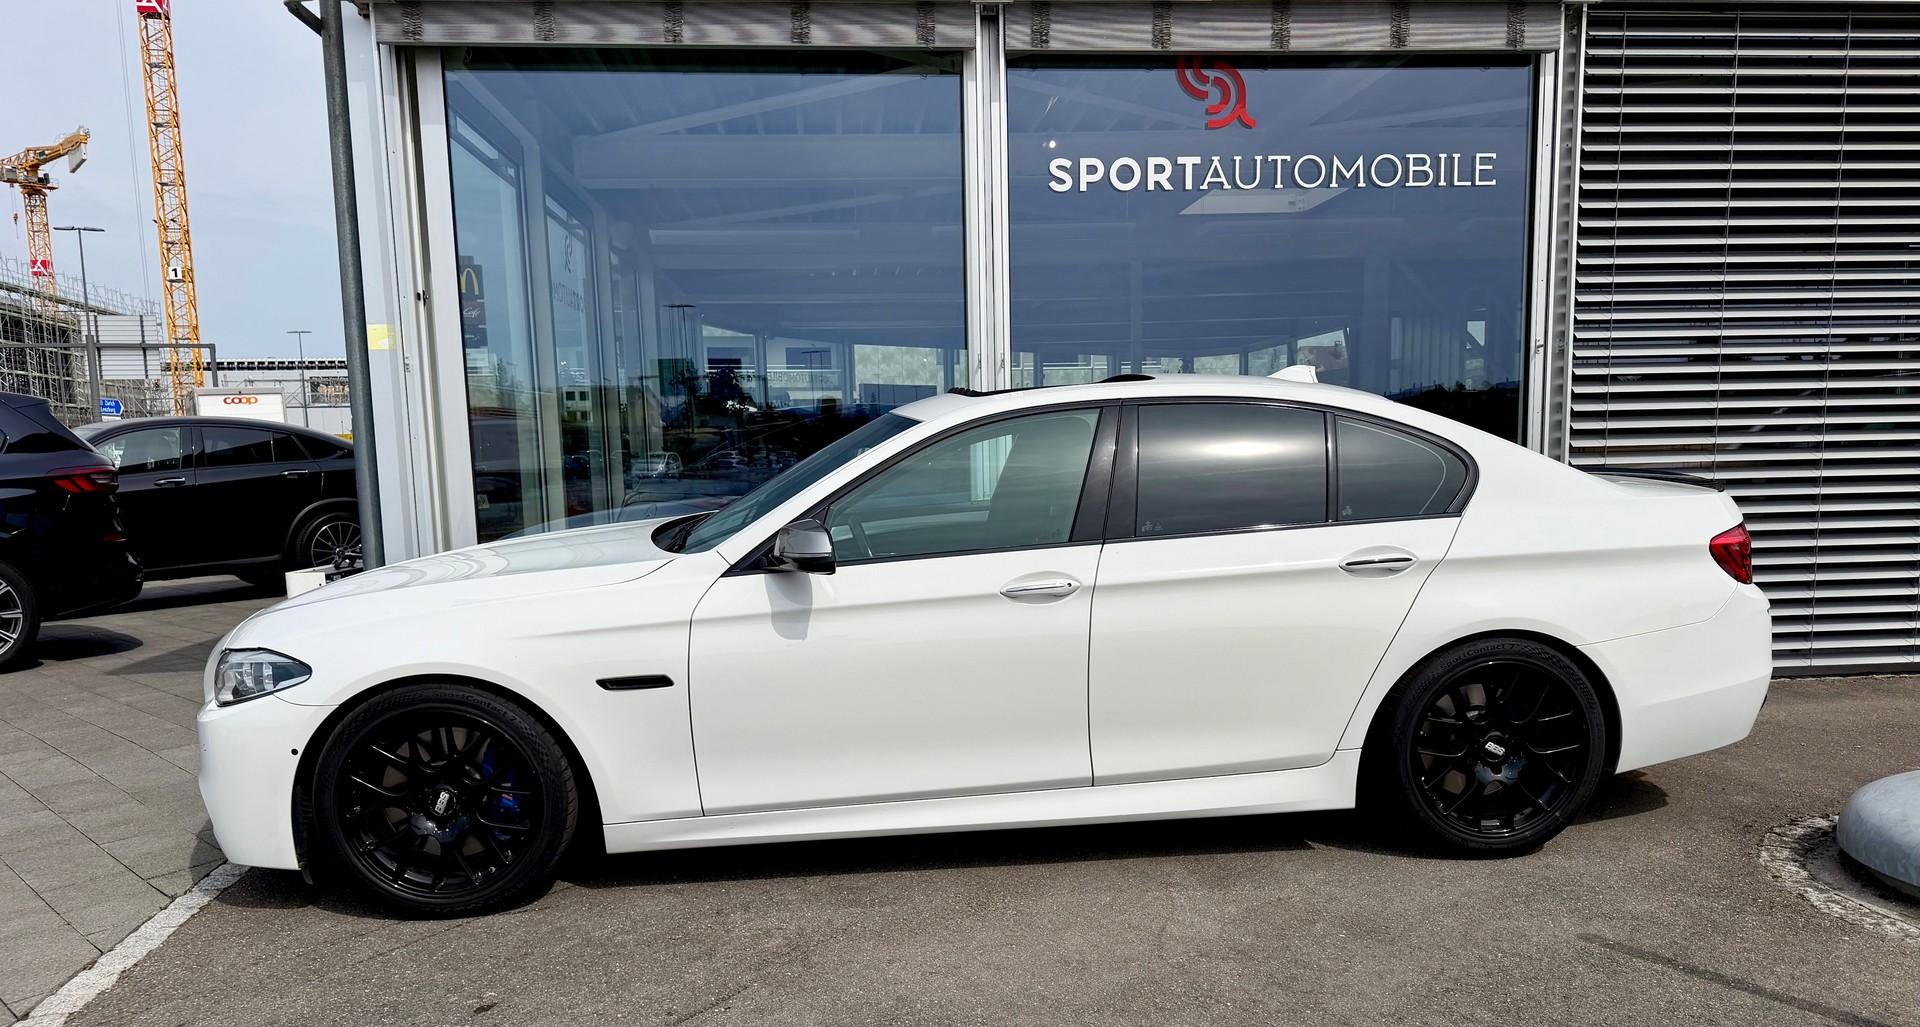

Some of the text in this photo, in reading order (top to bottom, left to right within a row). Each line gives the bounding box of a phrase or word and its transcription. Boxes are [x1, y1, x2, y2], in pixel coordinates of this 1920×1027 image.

[1048, 152, 1497, 192] SPORTAUTOMOBILE
[171, 267, 178, 278] 1
[223, 396, 258, 405] coop
[1440, 643, 1506, 671] SportContact
[432, 691, 507, 717] SportContact
[1485, 741, 1505, 756] BBS
[434, 791, 450, 815] BBS
